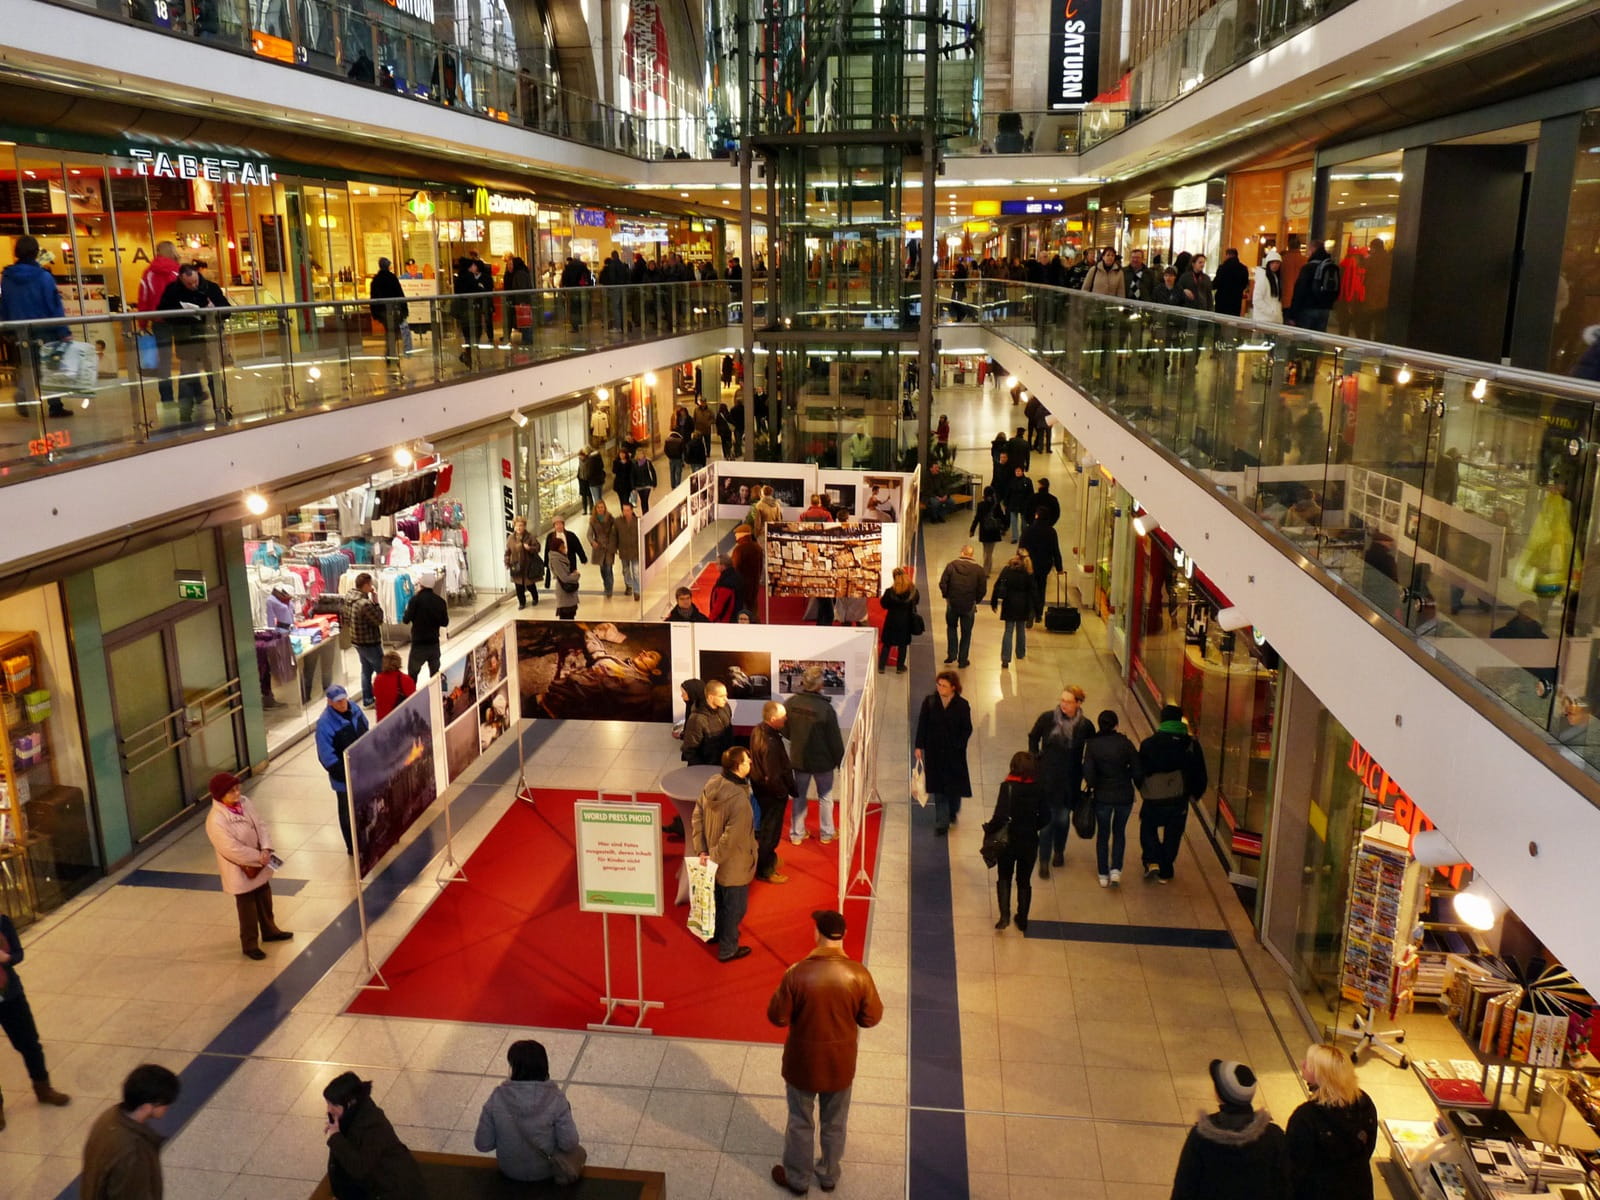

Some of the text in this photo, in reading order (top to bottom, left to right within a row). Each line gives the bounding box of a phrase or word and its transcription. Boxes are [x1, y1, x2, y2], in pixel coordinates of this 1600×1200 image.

[154, 0, 169, 20] 18
[1062, 20, 1086, 98] SATURN
[130, 149, 270, 187] TABETAI
[503, 485, 514, 538] EVER
[583, 812, 652, 824] WORLD PRESS PHOTO
[1347, 738, 1474, 890] McPapr
